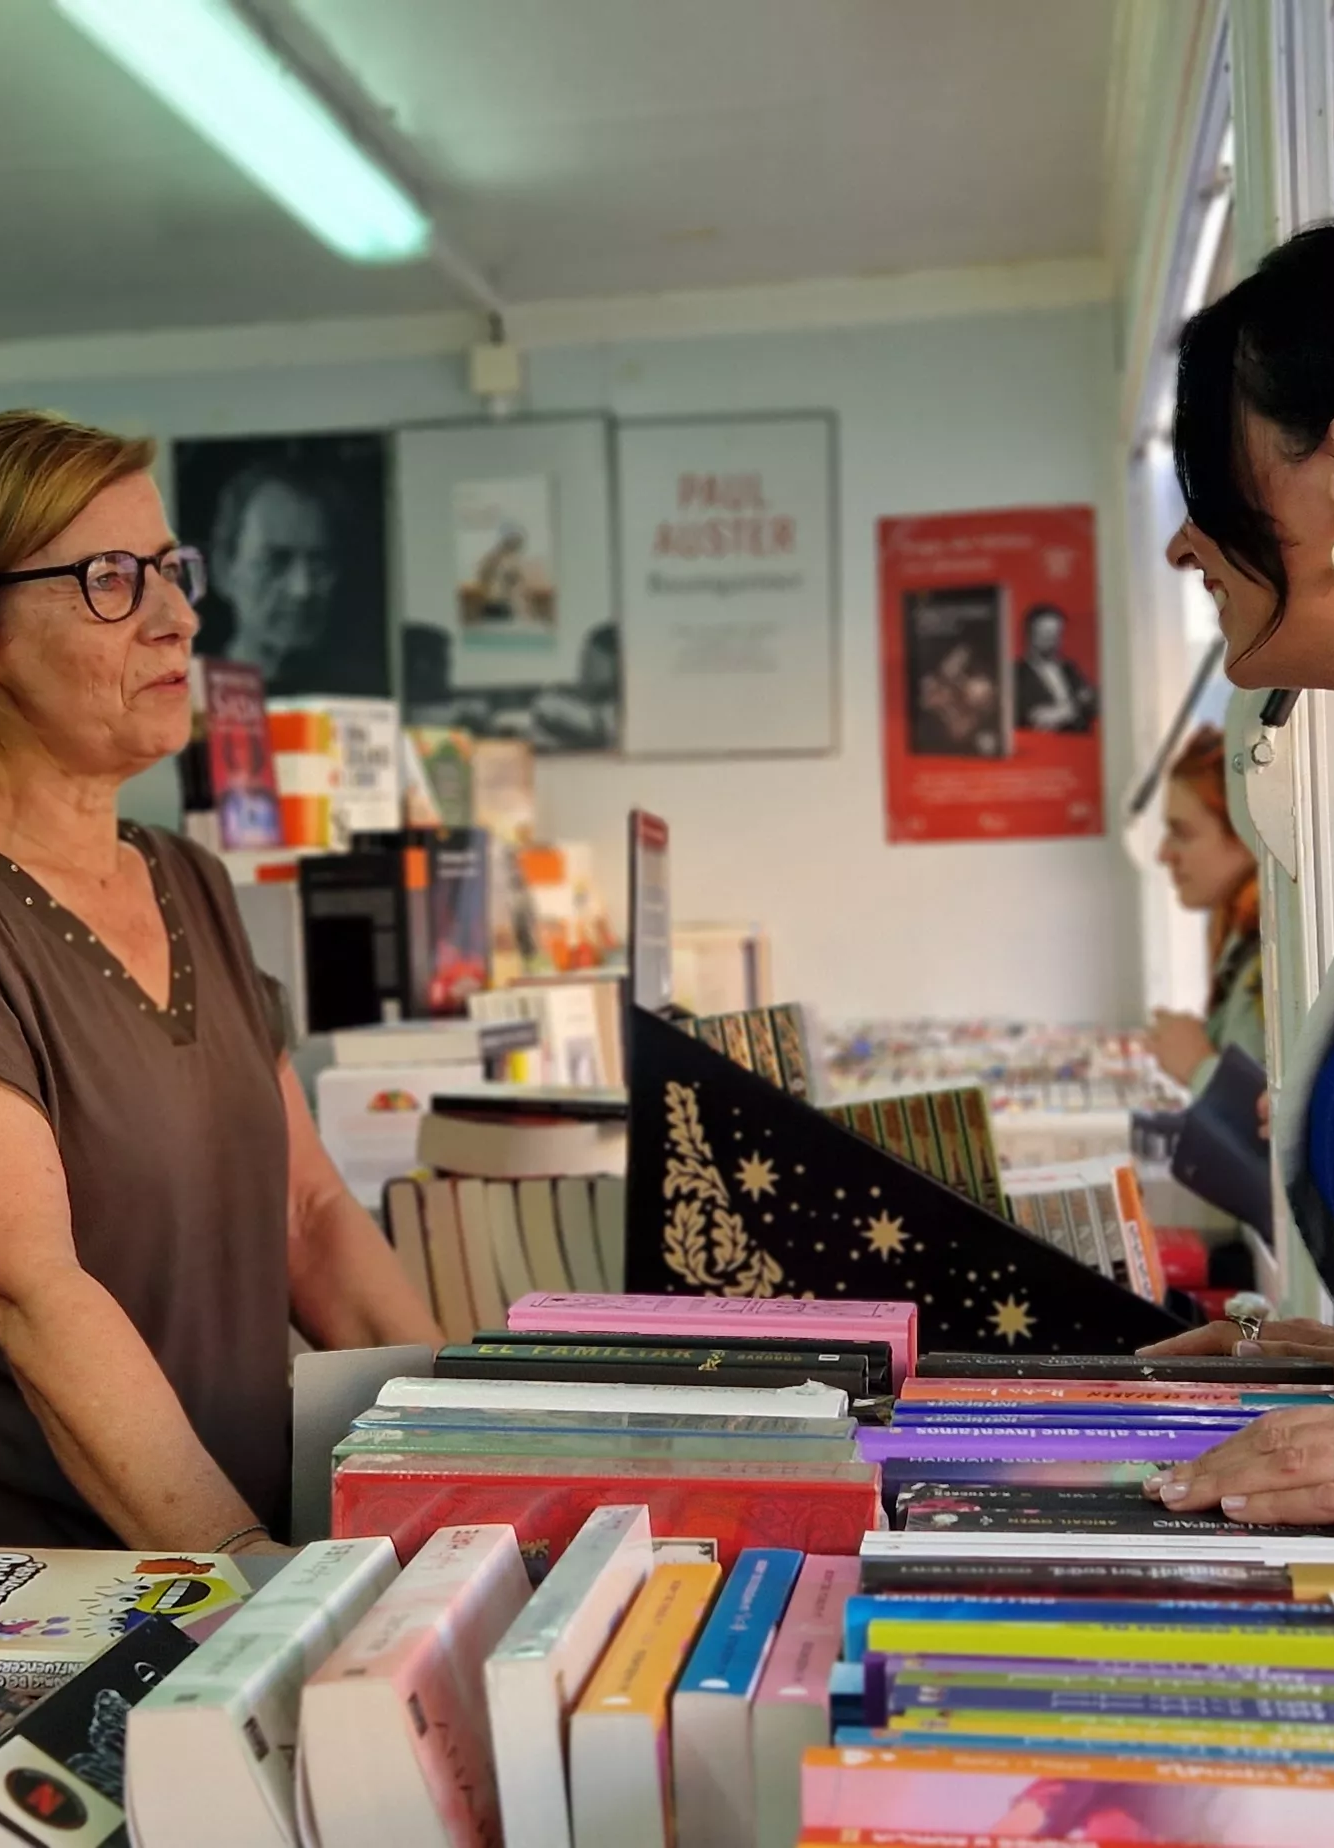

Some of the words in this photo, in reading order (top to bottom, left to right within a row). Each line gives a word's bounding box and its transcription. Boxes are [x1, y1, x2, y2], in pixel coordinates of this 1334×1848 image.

[677, 471, 764, 510] PAUL
[652, 516, 797, 560] AUSTER
[475, 1344, 515, 1356] EL
[531, 1345, 694, 1361] FAMILIAR
[915, 1426, 1037, 1437] inventamos
[1041, 1427, 1080, 1437] que
[1083, 1428, 1130, 1437] alas
[1135, 1429, 1177, 1438] Las
